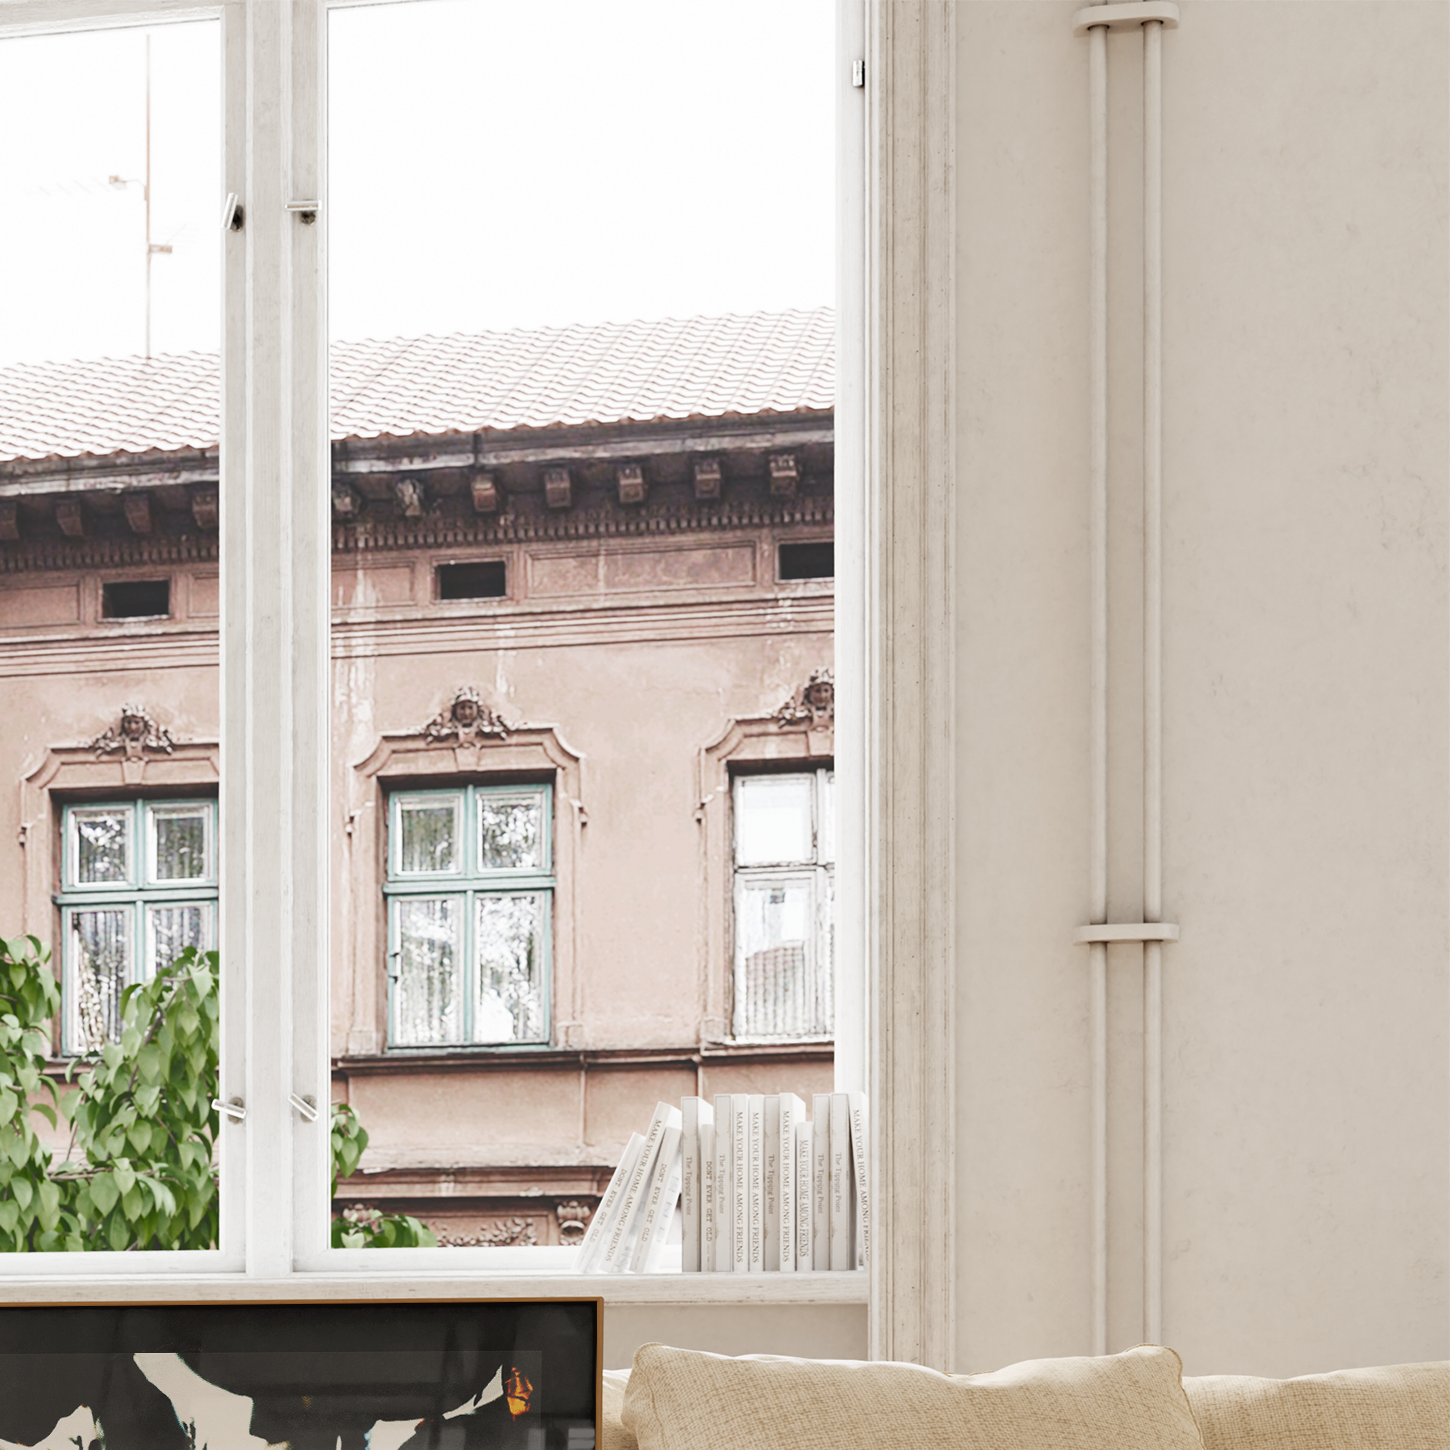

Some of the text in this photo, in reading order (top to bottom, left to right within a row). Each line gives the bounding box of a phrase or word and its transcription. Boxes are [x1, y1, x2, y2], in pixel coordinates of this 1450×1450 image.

[853, 1110, 861, 1135] MAKE
[855, 1136, 864, 1160] YOUR
[717, 1169, 725, 1196] Tipping
[834, 1168, 842, 1195] Tipping
[857, 1162, 866, 1188] HOME
[606, 1119, 661, 1262] MAKE YOUR HOME AMONG FRIENDS
